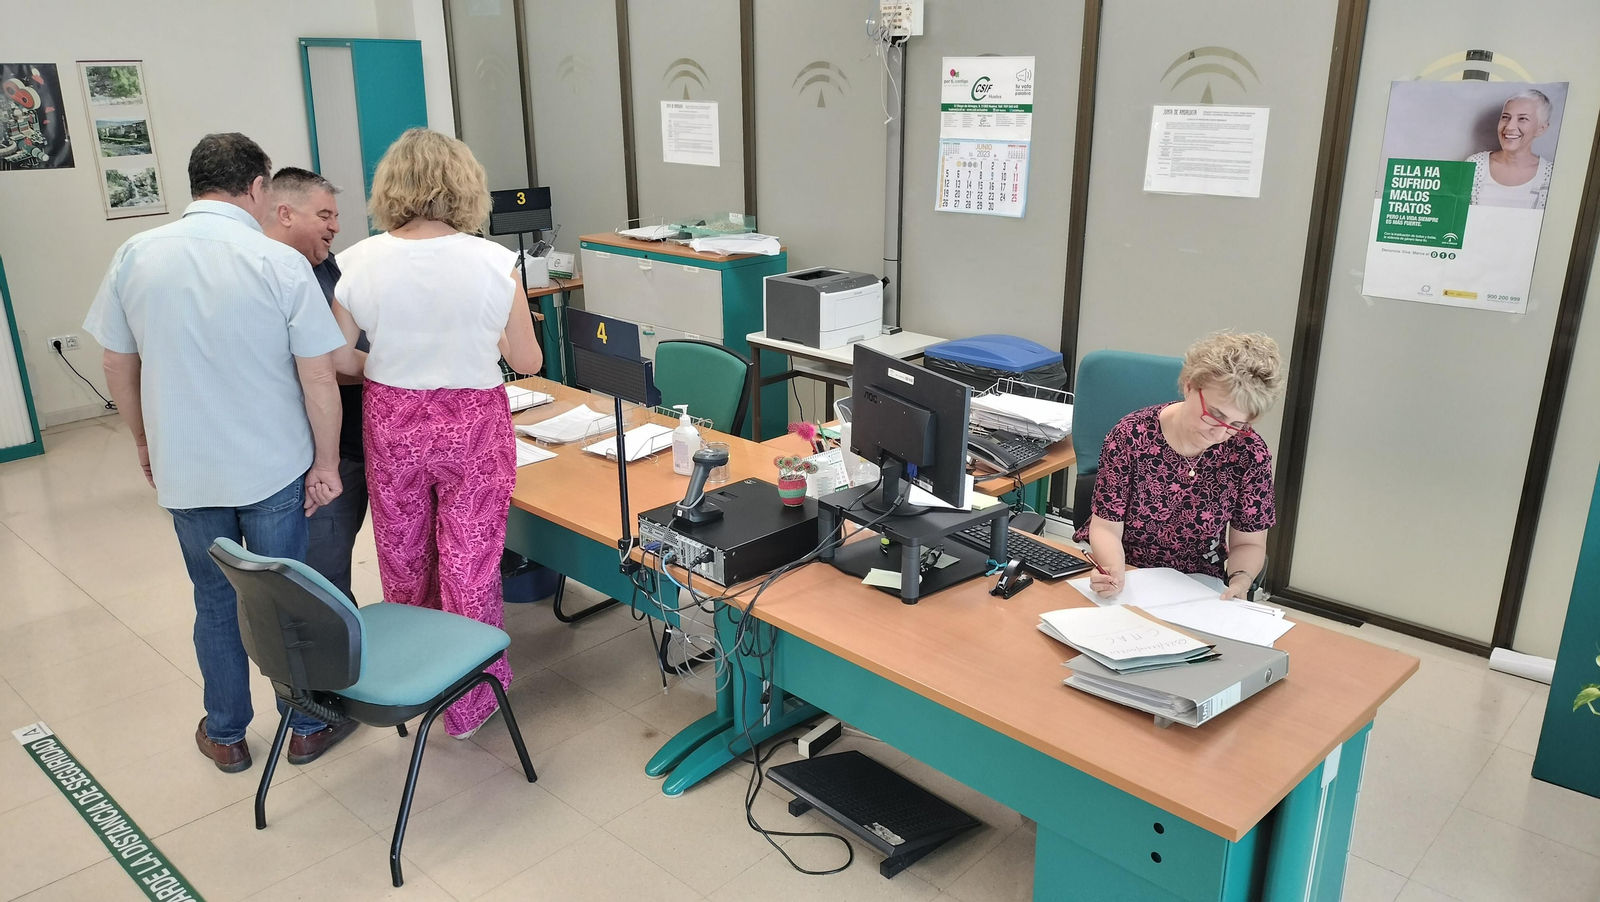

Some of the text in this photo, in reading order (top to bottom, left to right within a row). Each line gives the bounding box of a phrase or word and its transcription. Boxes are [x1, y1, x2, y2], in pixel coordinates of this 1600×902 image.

[976, 84, 993, 93] CSIF
[980, 161, 982, 169] 1
[991, 162, 994, 170] 2
[1003, 162, 1006, 170] 3
[1393, 165, 1440, 177] ELLA HA
[968, 171, 971, 179] 7
[1002, 172, 1006, 181] 10
[1014, 173, 1018, 182] 11
[945, 179, 949, 187] 12
[956, 180, 960, 188] 13
[967, 181, 972, 189] 14
[978, 181, 983, 189] 15
[989, 182, 994, 190] 16
[1001, 183, 1006, 191] 17
[1391, 177, 1440, 190] SUFRIDO
[516, 192, 526, 204] 3
[955, 190, 960, 198] 20
[966, 191, 972, 199] 21
[977, 191, 982, 200] 22
[989, 192, 994, 200] 23
[1000, 193, 1005, 201] 24
[1011, 194, 1017, 202] 25
[1390, 190, 1430, 202] MALOS
[943, 199, 948, 207] 26
[966, 200, 971, 209] 28
[988, 202, 994, 210] 30
[1388, 202, 1431, 214] TRATOS
[597, 322, 608, 344] 4
[864, 391, 877, 404] AOC
[31, 738, 91, 791] SEGURIDAD
[72, 786, 104, 806] DE
[86, 799, 148, 859] DISTANCIA
[130, 852, 162, 875] LA
